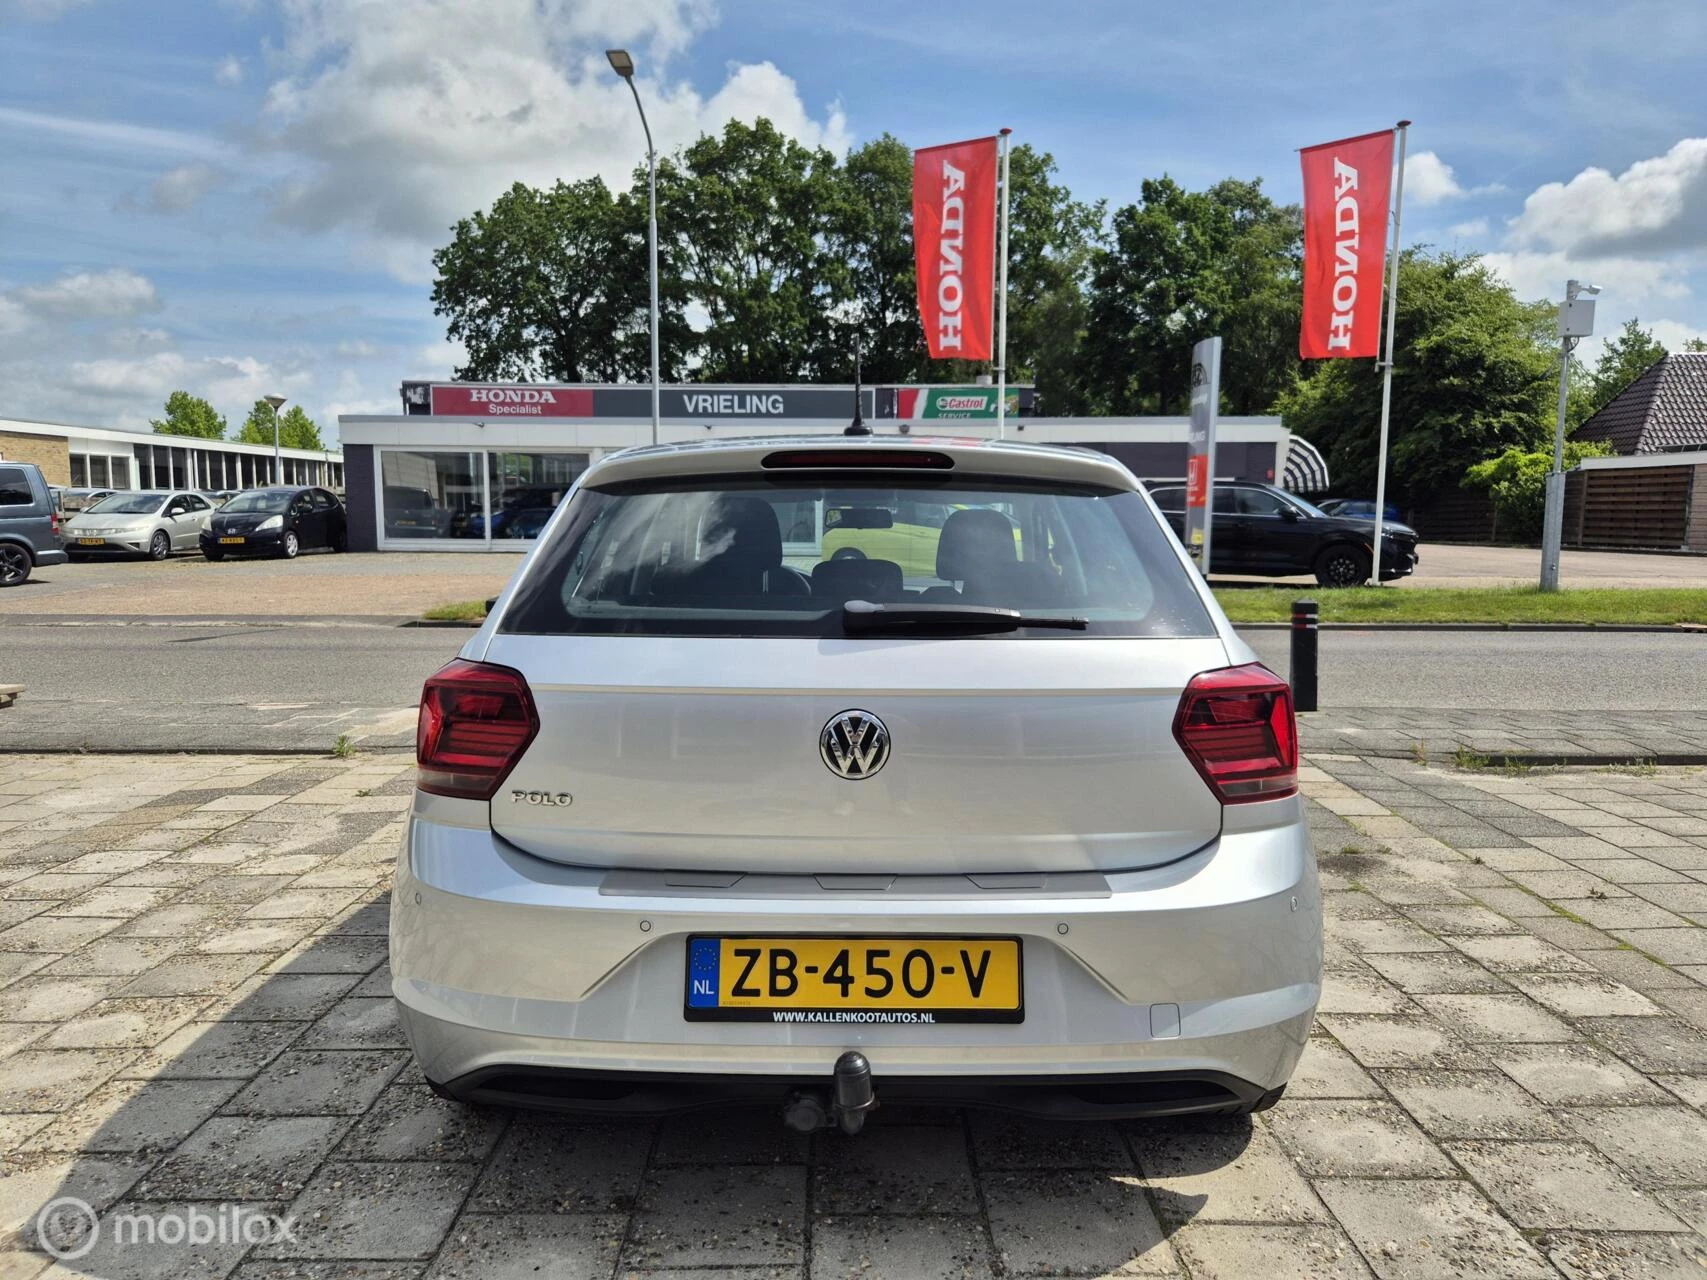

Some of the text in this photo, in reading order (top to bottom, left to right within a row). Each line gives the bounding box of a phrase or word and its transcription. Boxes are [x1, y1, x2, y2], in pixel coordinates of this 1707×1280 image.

[470, 389, 557, 404] HONDA
[682, 394, 785, 414] VRIELING
[948, 397, 985, 409] Castrol
[488, 403, 542, 415] Specialist
[511, 789, 573, 807] POLO
[731, 949, 991, 999] ZB-450-V
[693, 980, 715, 995] NL
[772, 1011, 936, 1024] WWW.KALLENKOOTAUTOS.NL
